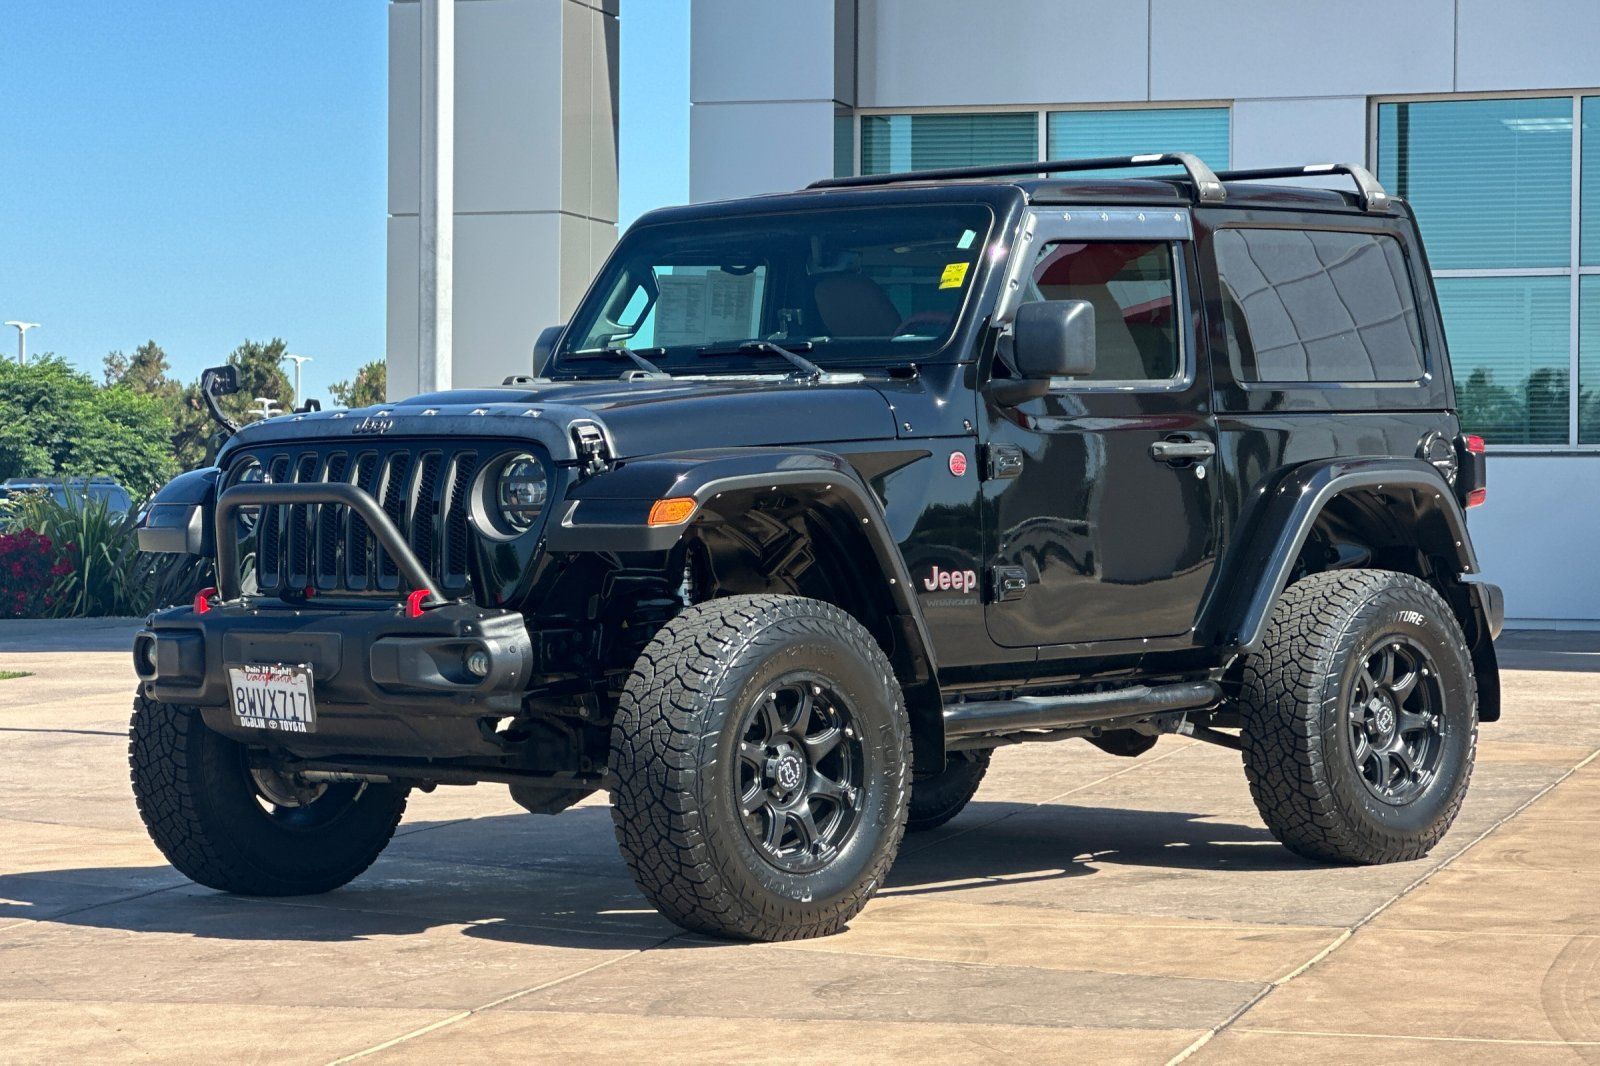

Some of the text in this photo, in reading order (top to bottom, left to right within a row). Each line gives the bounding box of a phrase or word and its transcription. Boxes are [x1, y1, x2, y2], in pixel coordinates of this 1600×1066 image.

[924, 566, 976, 593] Jeep
[236, 687, 307, 723] 8WVX717
[240, 716, 307, 733] DUBLIN TOYOTA
